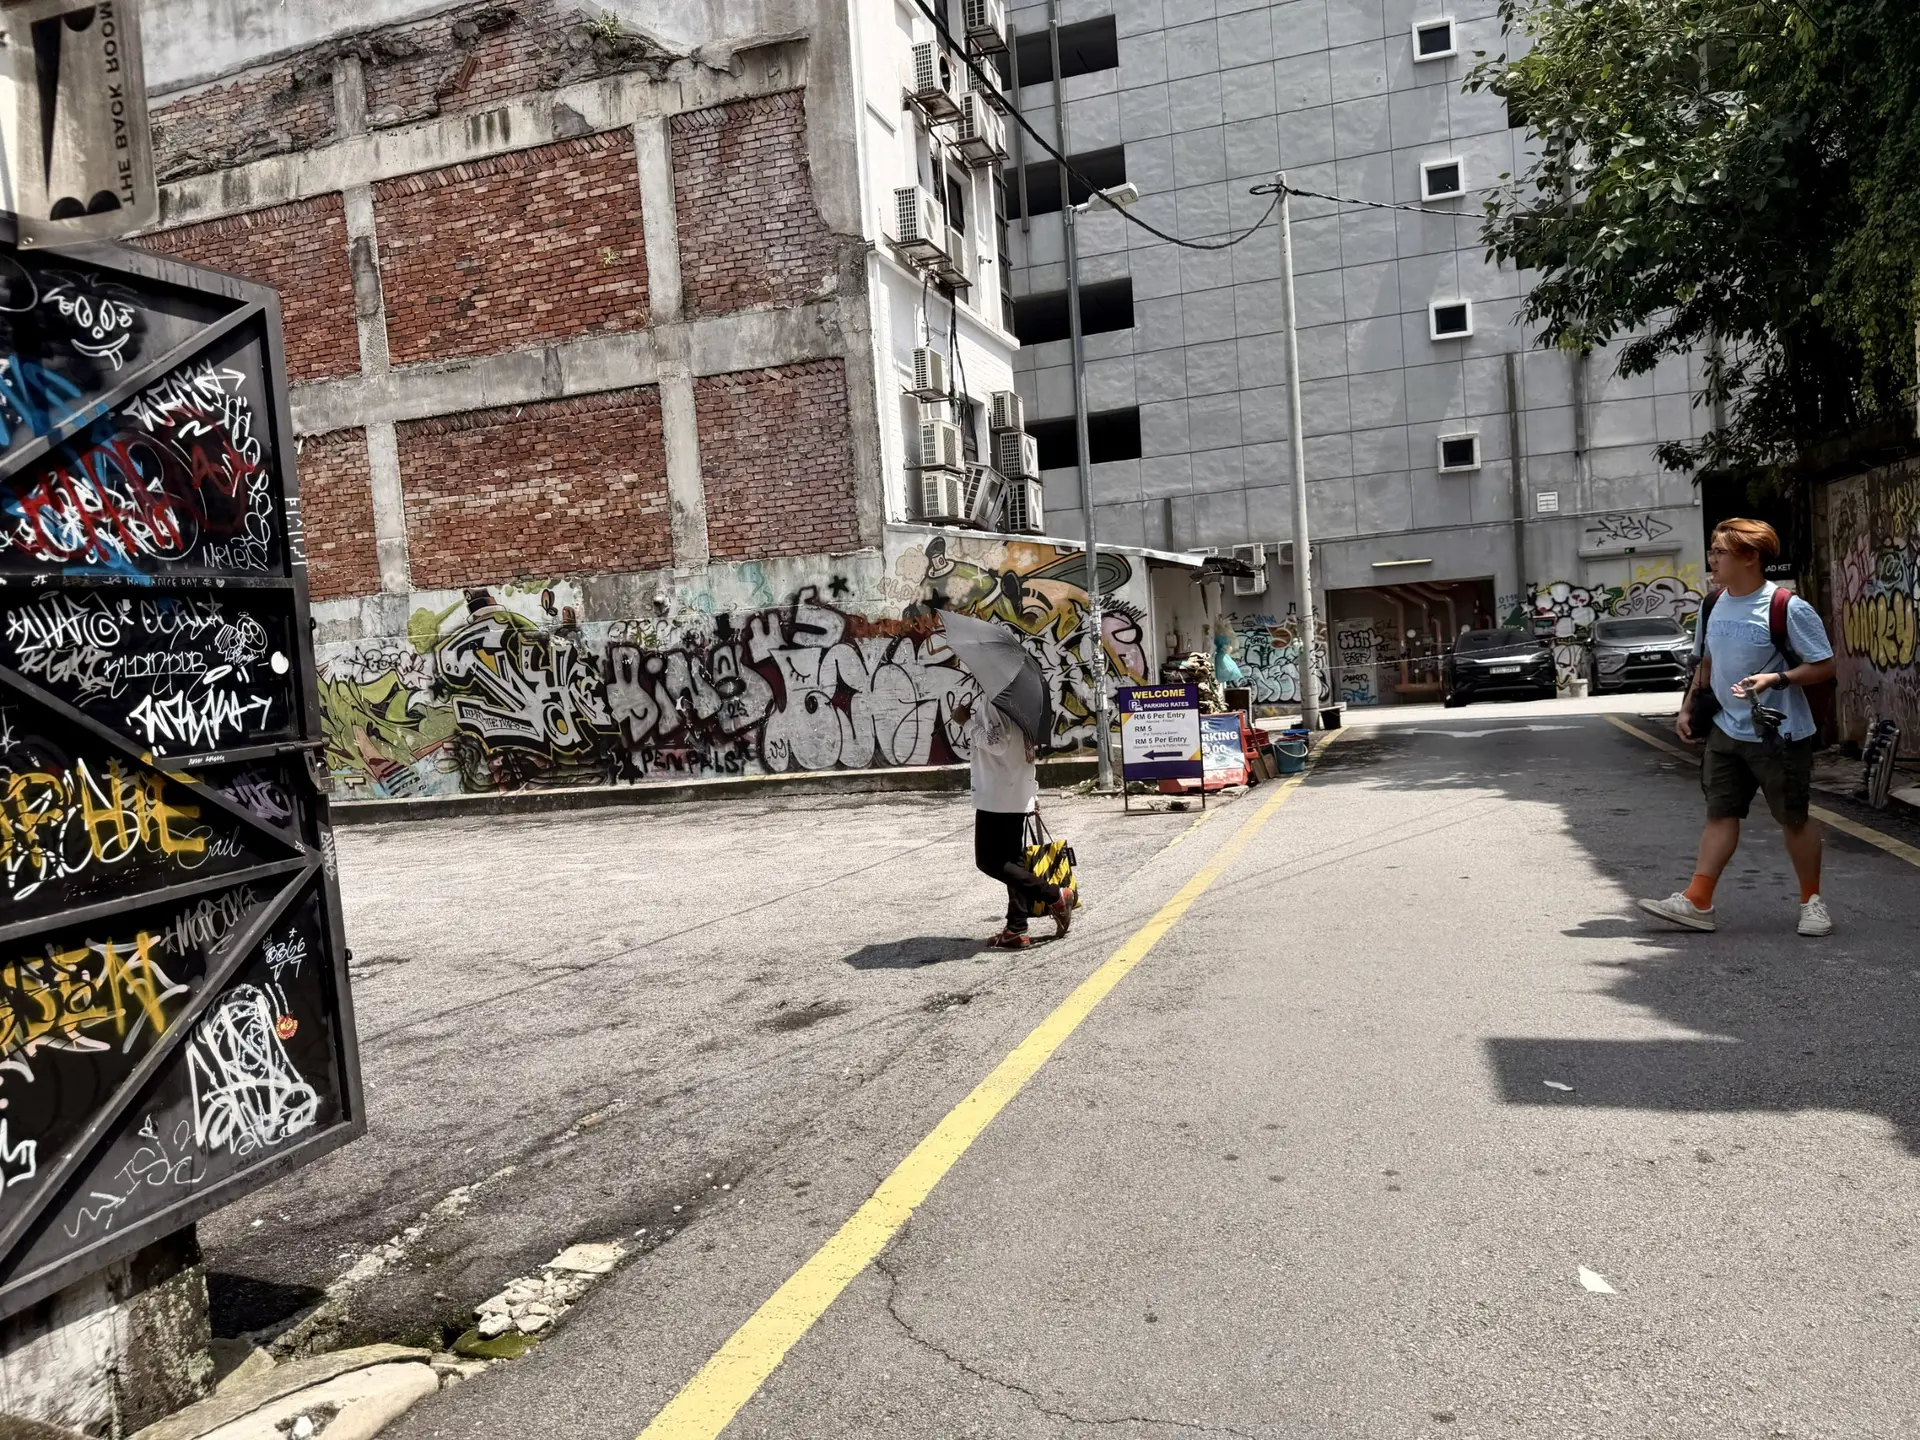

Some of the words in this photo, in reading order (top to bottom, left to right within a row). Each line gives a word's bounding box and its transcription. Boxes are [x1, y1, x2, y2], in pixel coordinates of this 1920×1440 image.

[1765, 565, 1777, 573] AD
[1132, 689, 1185, 699] WELCOME
[1167, 711, 1186, 720] Entry
[1168, 737, 1187, 745] Entry
[1201, 731, 1239, 742] RKING
